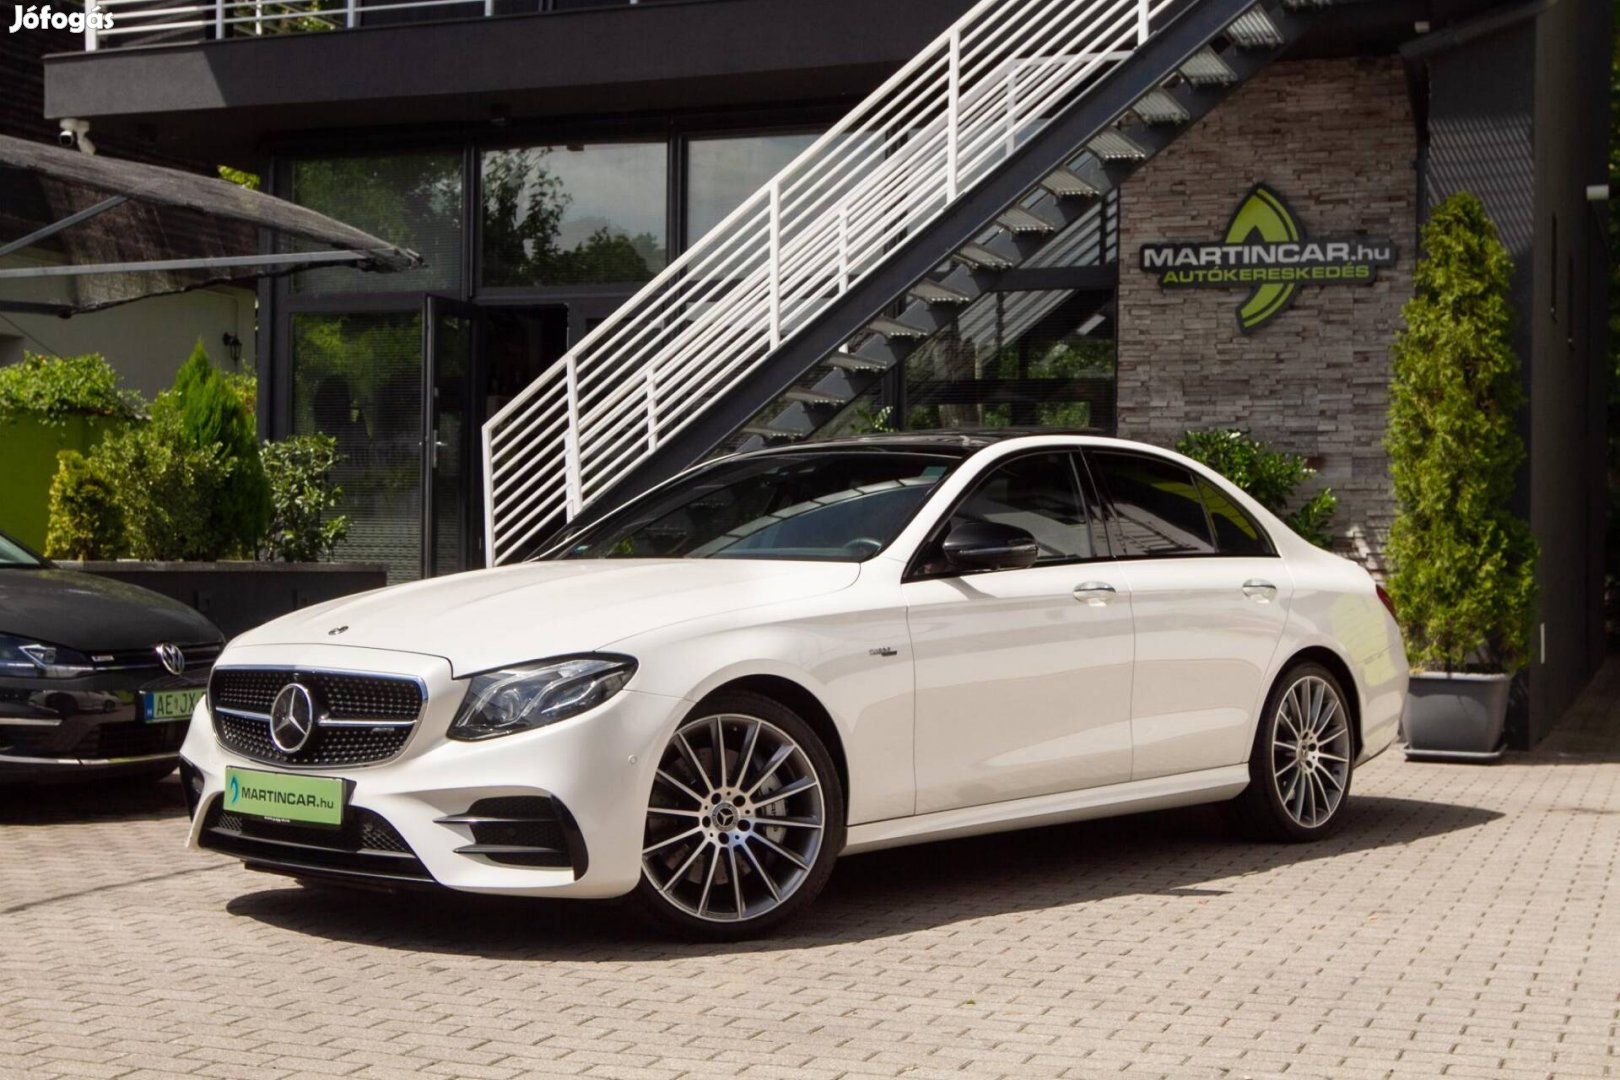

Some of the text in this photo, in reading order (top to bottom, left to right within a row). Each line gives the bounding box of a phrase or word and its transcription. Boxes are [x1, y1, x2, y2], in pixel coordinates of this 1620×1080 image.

[1144, 243, 1390, 267] MARTINCAR.hu
[1163, 262, 1370, 283] AUTÓKERESKEDÉS
[241, 786, 334, 809] MARTINCAR.hu
